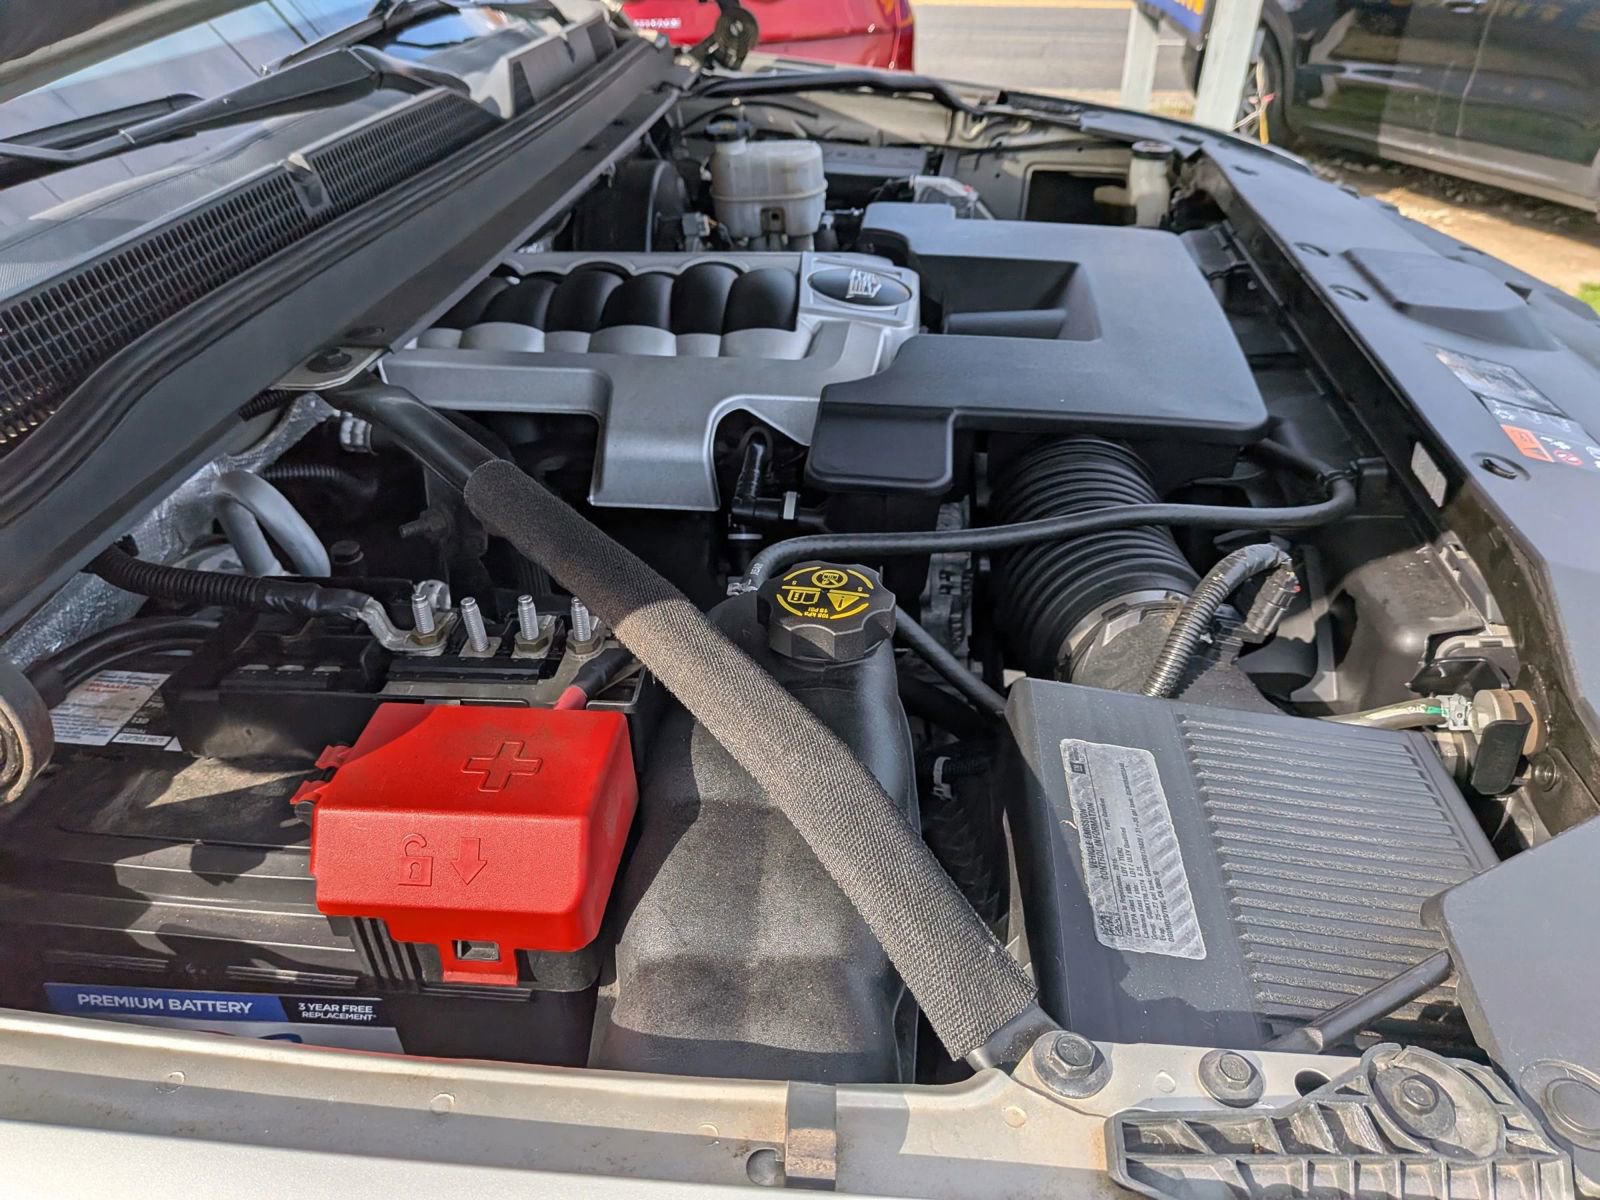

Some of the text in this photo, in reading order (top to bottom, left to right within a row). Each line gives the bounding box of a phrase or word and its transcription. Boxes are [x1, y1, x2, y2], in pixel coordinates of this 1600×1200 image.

[1080, 808, 1098, 869] VEHICLE EMISSION
[1087, 802, 1109, 880] CONTROL INFORMATION
[77, 993, 252, 1014] PREMIUM BATTERY
[298, 1002, 373, 1013] 3 YEAR FREE
